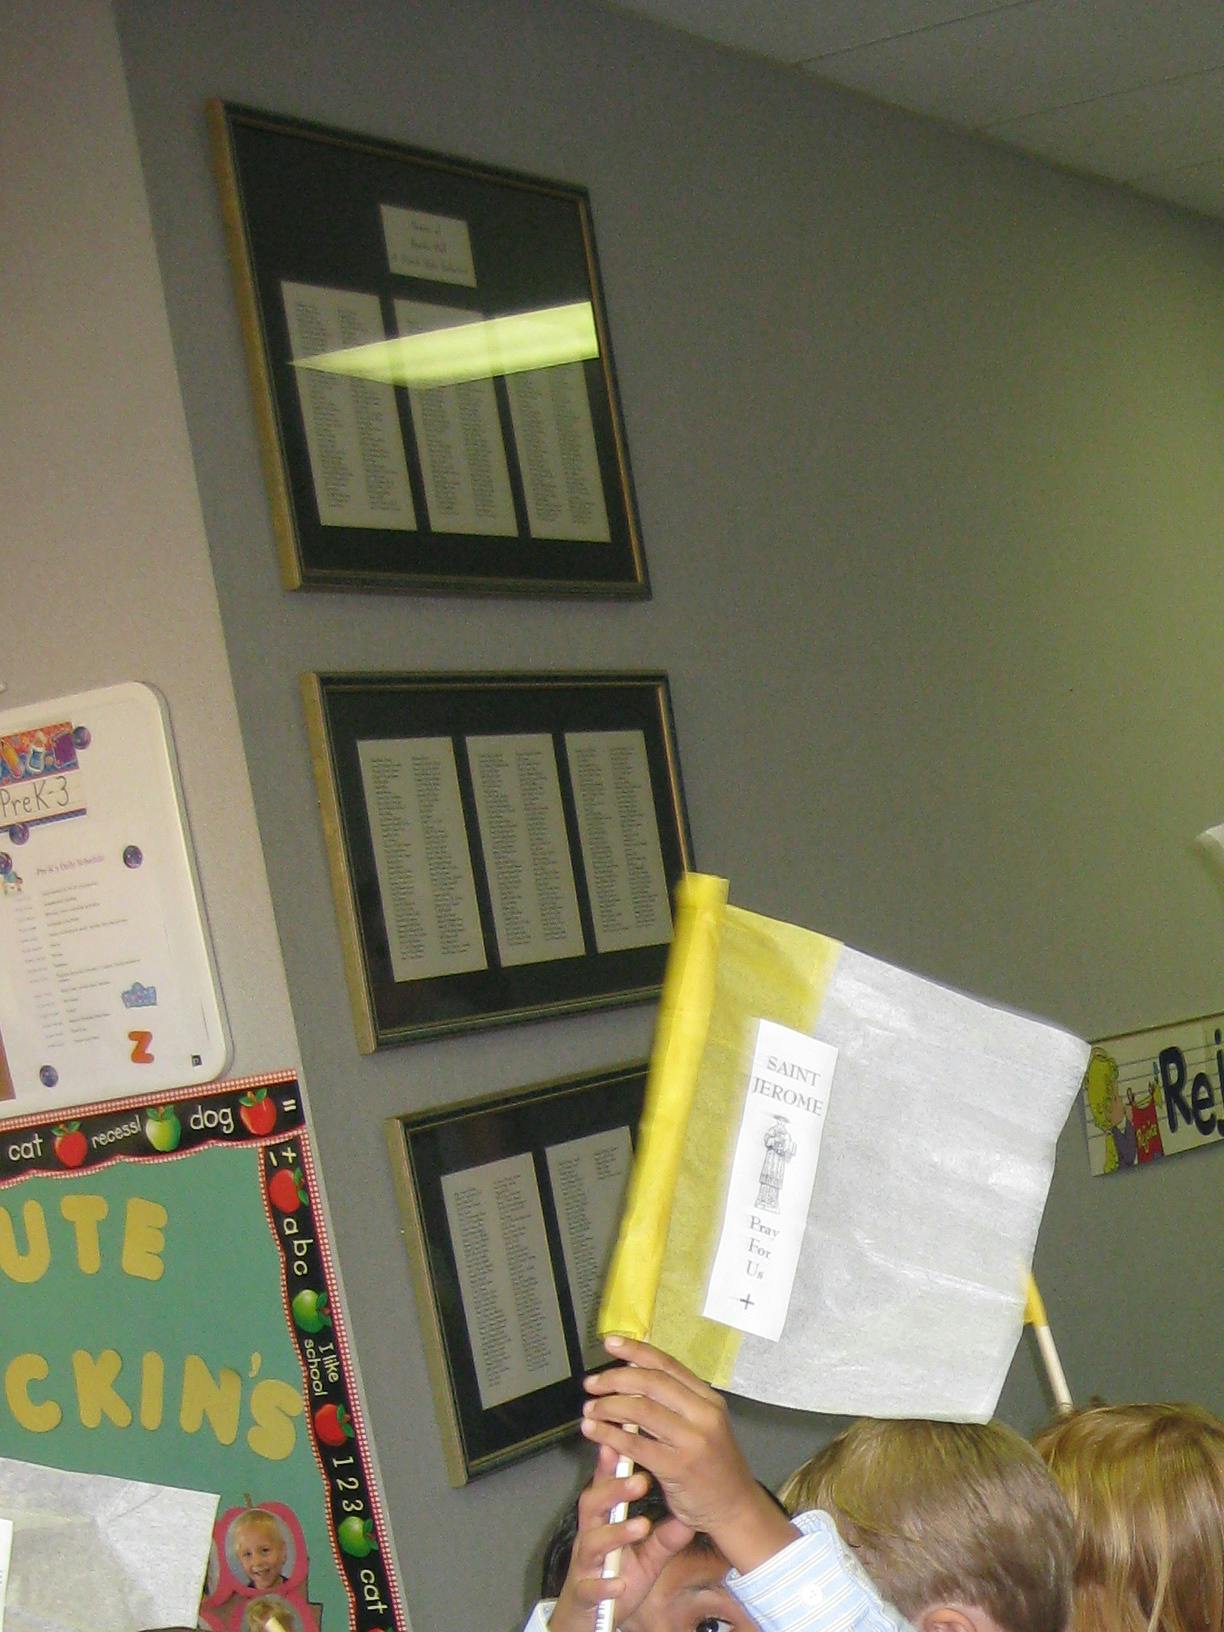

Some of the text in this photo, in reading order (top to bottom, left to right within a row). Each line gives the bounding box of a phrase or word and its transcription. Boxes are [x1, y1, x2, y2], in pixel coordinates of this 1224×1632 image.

[0, 775, 70, 818] PreK-3
[766, 1055, 822, 1087] SAINT
[752, 1077, 824, 1117] JEROME
[91, 1115, 142, 1150] recess!
[189, 1105, 236, 1134] dog
[8, 1133, 44, 1162] cat
[749, 1215, 781, 1239] Pray
[748, 1238, 771, 1258] For
[745, 1259, 766, 1281] Us
[304, 1338, 329, 1397] school
[321, 1354, 340, 1384] like
[360, 1569, 388, 1615] cat
